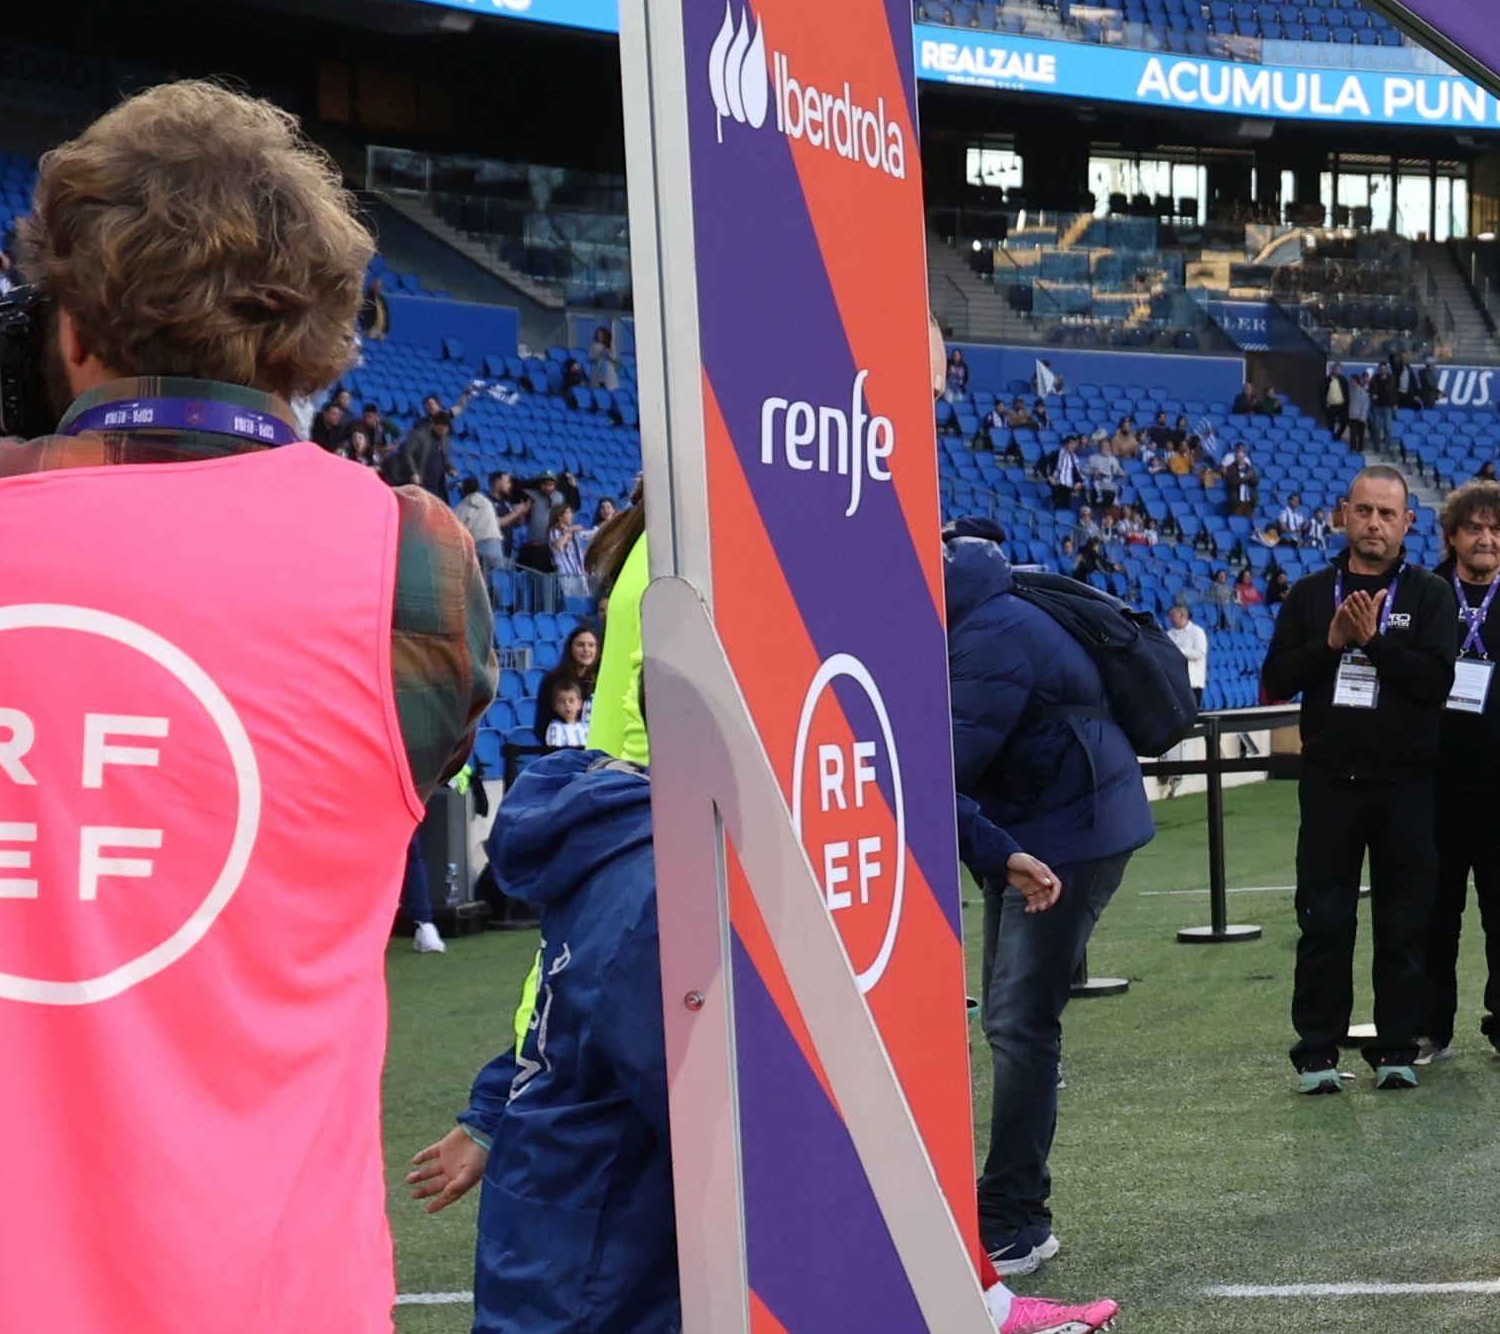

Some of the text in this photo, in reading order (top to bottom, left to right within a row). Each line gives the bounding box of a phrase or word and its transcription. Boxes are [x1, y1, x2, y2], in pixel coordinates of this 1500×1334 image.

[921, 40, 1057, 85] REALZALE
[1137, 58, 1370, 119] ACUMULA
[773, 51, 906, 180] Iberdrola
[762, 369, 896, 517] renfe
